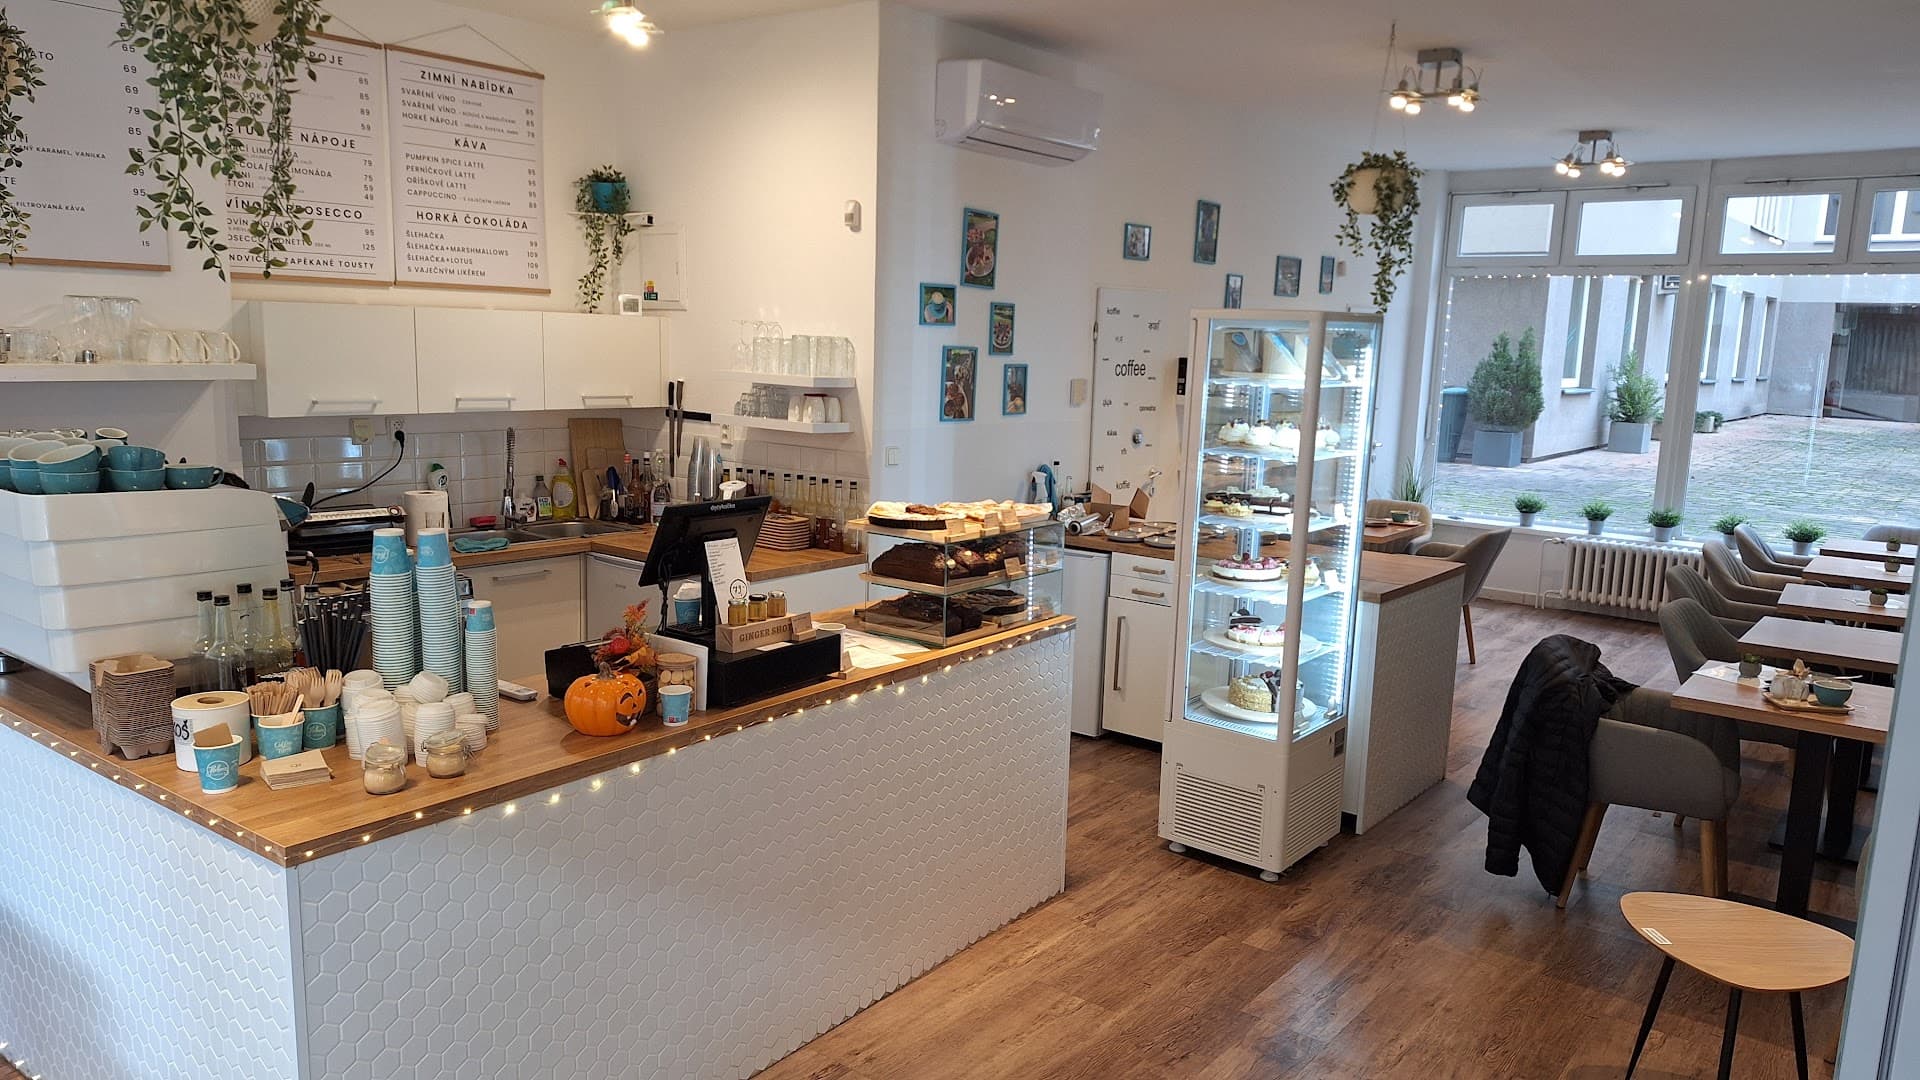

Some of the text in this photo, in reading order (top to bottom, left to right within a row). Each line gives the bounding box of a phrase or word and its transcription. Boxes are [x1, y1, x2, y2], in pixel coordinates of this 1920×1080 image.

[122, 44, 136, 53] 65
[123, 65, 137, 74] 69
[420, 70, 514, 95] ZIMNÍ NABÍDKA
[125, 85, 139, 94] 69
[401, 87, 435, 99] SVAŘENÉ
[127, 106, 140, 115] 79
[402, 99, 435, 111] SVAŘENÉ
[438, 104, 456, 114] VÍNO
[402, 112, 427, 122] HORKÉ
[430, 115, 458, 126] NÁPOJE
[128, 127, 142, 136] 85
[301, 132, 356, 149] NÁPOJE
[454, 137, 487, 150] KÁVA
[36, 147, 72, 156] KARAMEL,
[75, 151, 106, 159] VANILKA
[406, 153, 439, 163] PUMPKIN
[442, 157, 462, 166] SPICE
[464, 160, 484, 169] LATTE
[406, 165, 452, 177] PERNÍČKOVÉ
[455, 171, 476, 179] LATTE
[406, 176, 444, 188] OŘÍŠKOVÉ
[447, 182, 467, 190] LATTE
[133, 188, 146, 197] 95
[407, 189, 457, 200] CAPPUCCINO
[16, 202, 86, 212] FILTROVANÁ KÁVA
[417, 211, 528, 230] HORKÁ ČOKOLÁDA
[406, 229, 445, 240] ŠLEHAČKA
[362, 243, 375, 251] 125
[338, 260, 374, 270] TOUSTY
[415, 266, 455, 275] VAJEČNÝM
[457, 268, 485, 277] LIKÉREM
[1115, 360, 1146, 377] coffee
[739, 628, 770, 642] GINGER
[174, 720, 190, 740] OŠ
